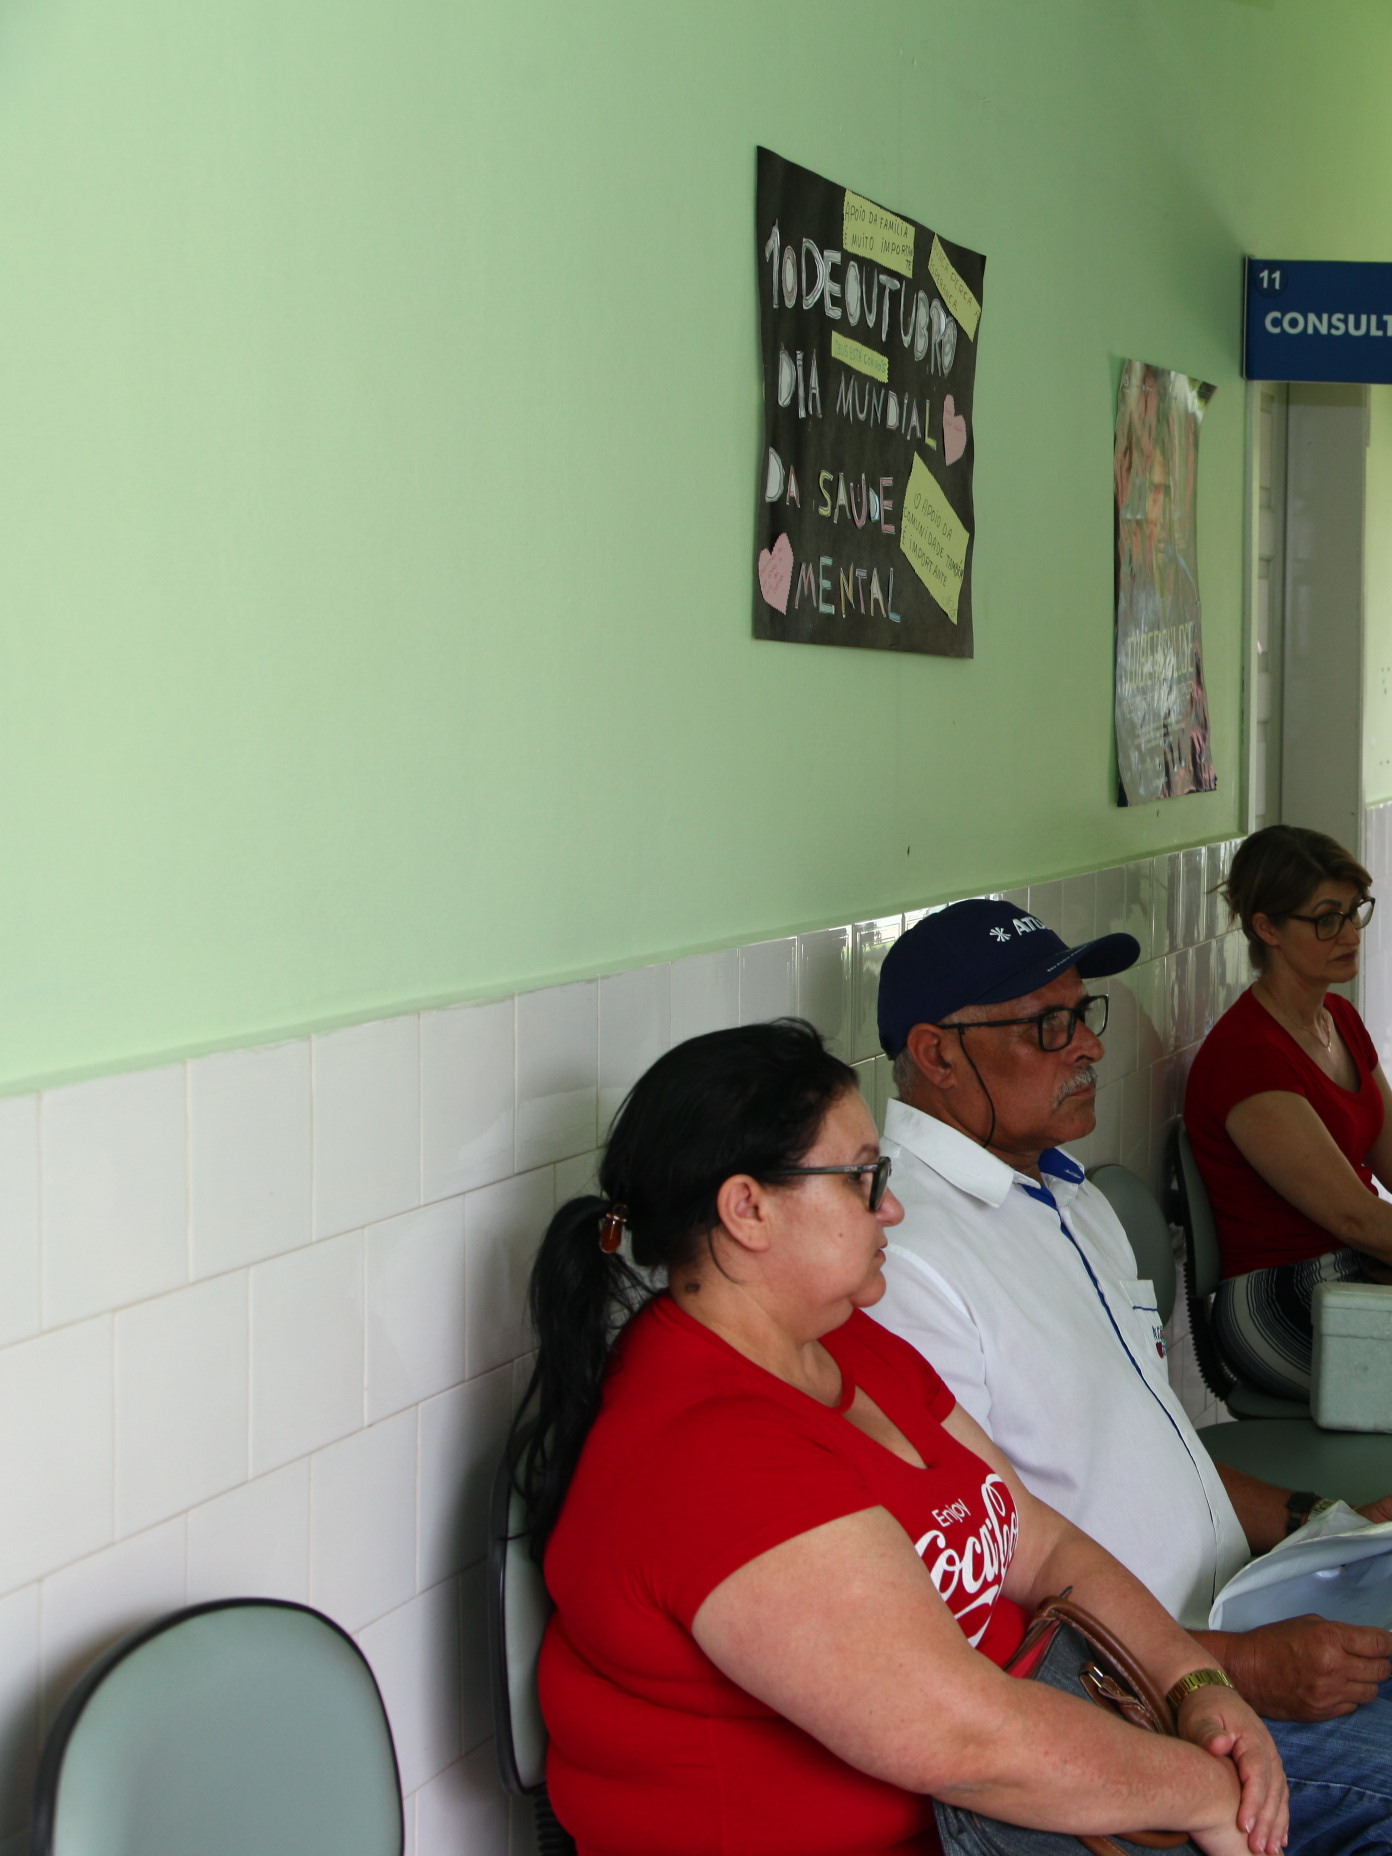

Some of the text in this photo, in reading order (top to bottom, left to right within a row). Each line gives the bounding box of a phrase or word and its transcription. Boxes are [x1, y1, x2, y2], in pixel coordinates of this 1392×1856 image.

[764, 219, 957, 378] 10 DE OUTUBRO
[1259, 269, 1281, 290] 11
[777, 347, 937, 450] DIA MUNDIAL
[765, 447, 801, 508] DA
[795, 556, 900, 623] MENTAL
[931, 1498, 972, 1528] Enjoy
